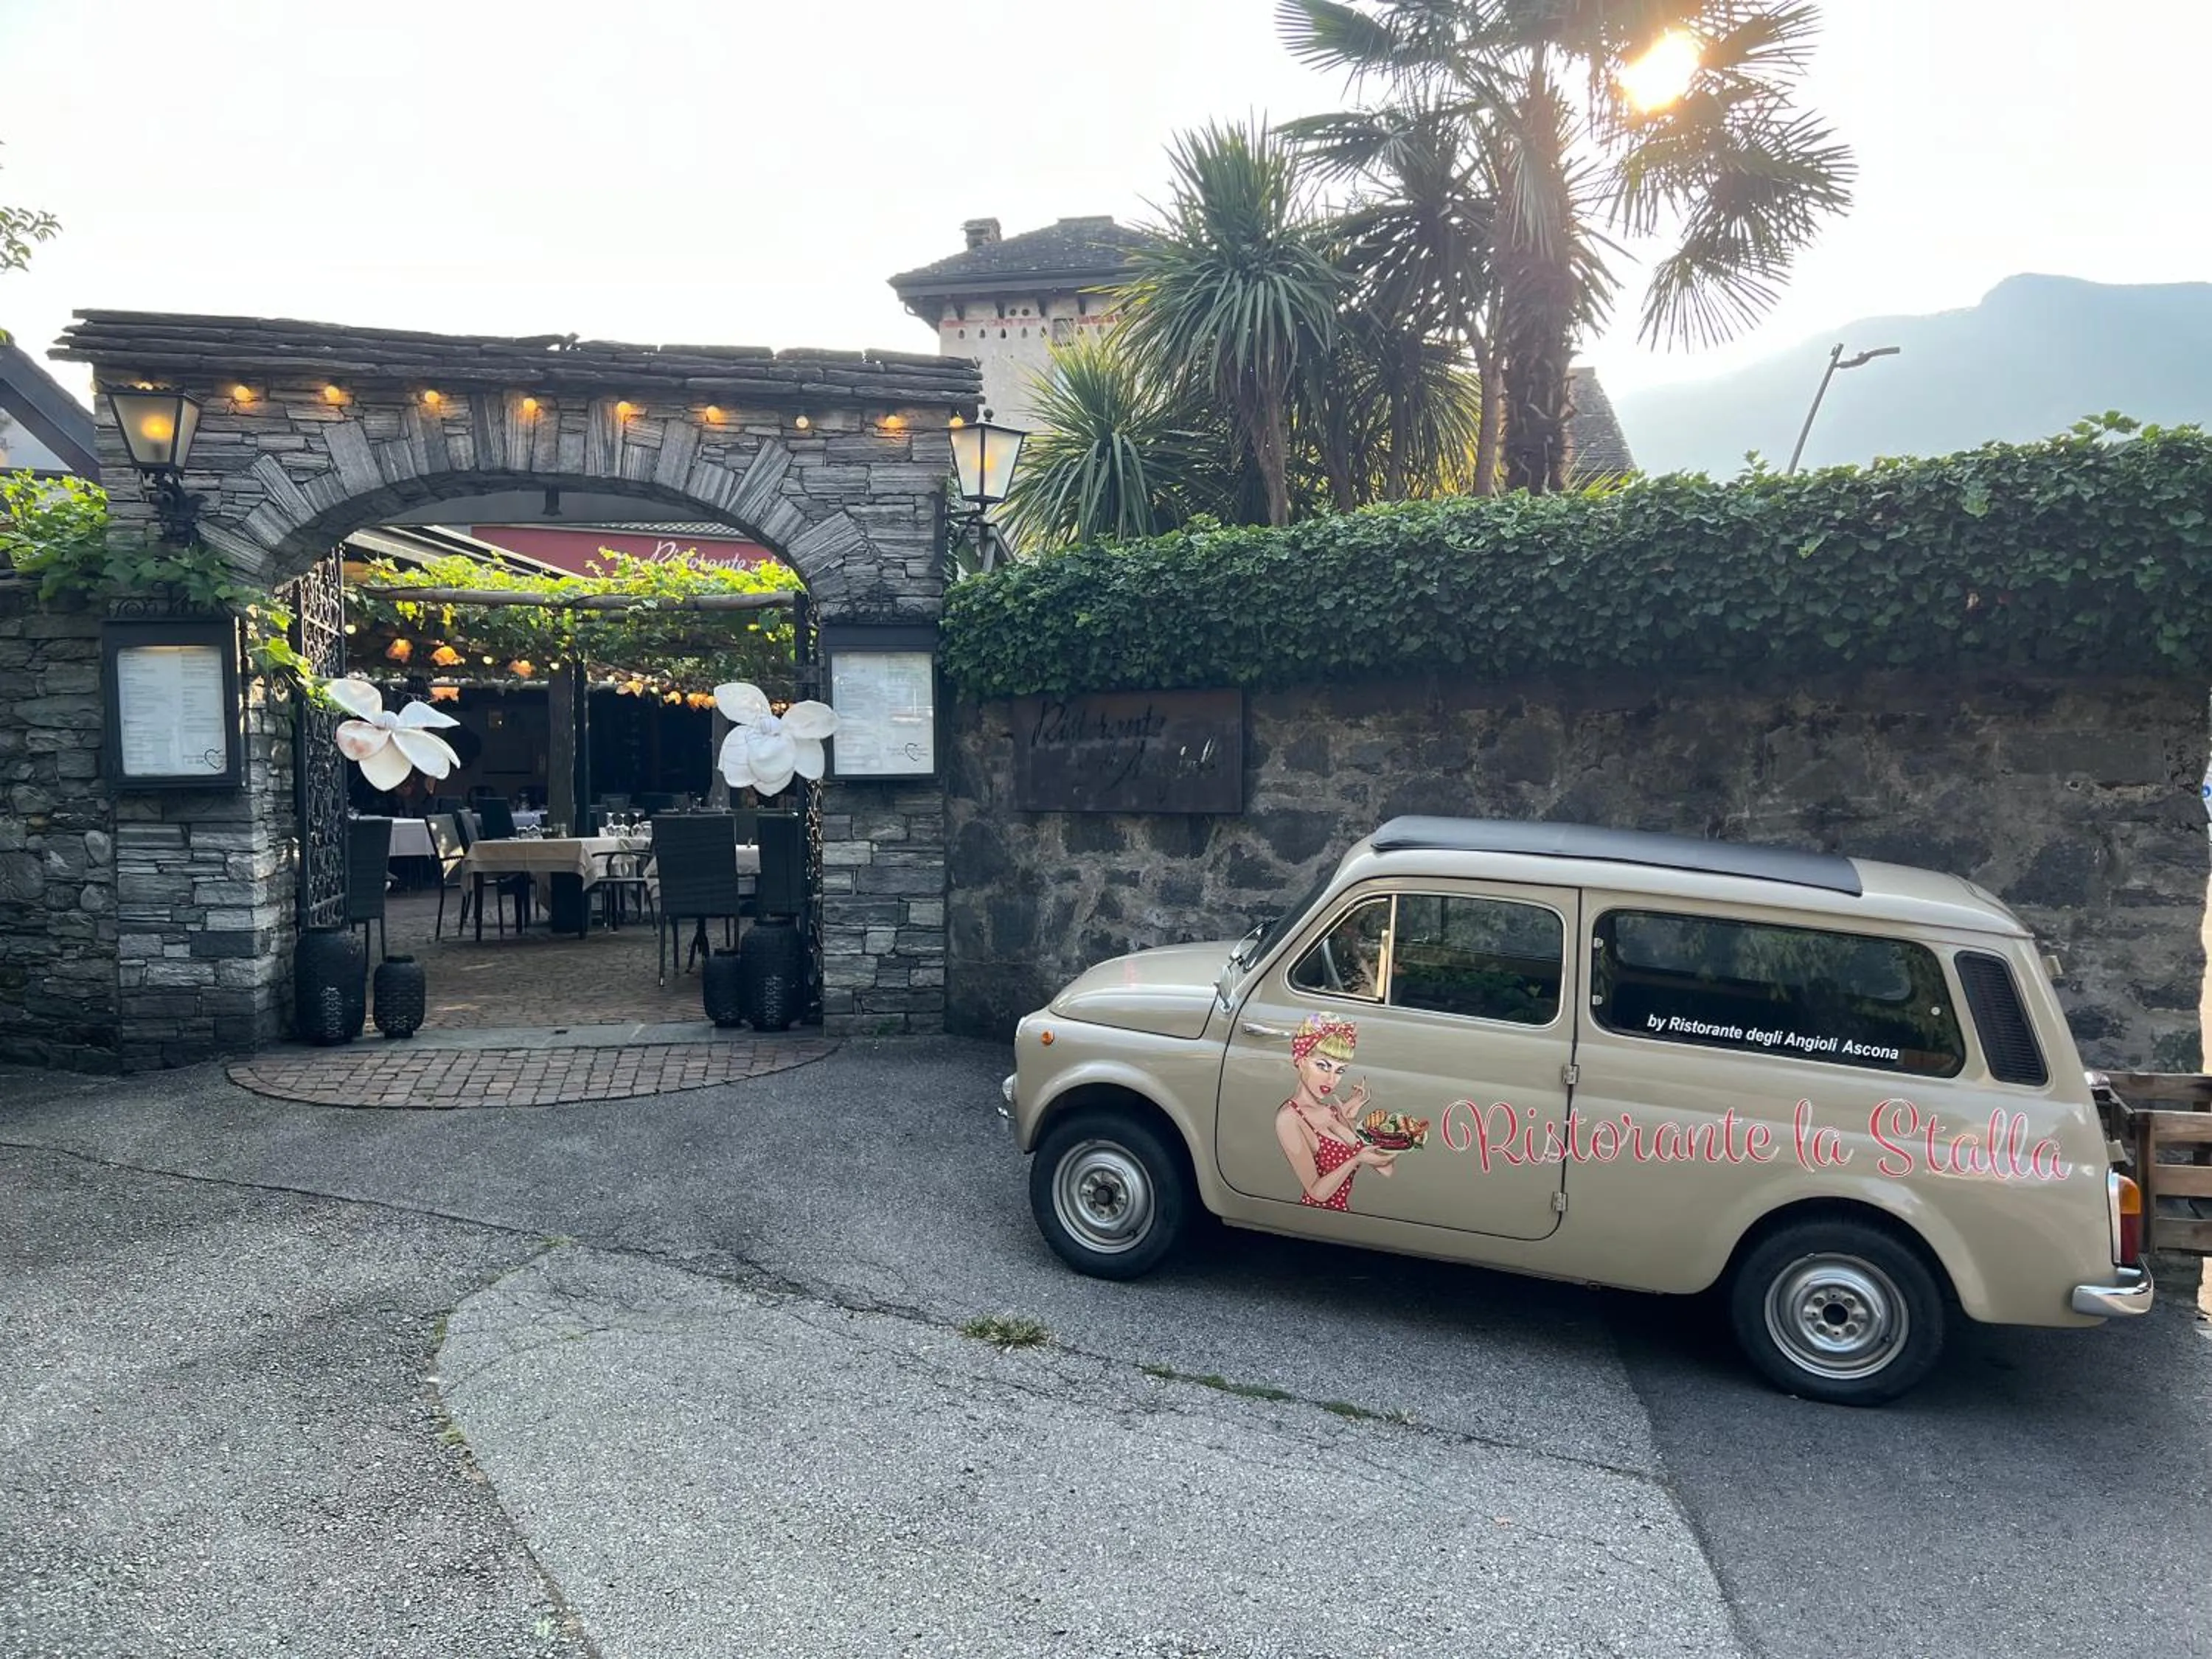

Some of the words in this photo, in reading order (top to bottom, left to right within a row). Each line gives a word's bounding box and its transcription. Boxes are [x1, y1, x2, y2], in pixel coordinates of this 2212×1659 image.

[1646, 1014, 1666, 1032] by
[1668, 1016, 1743, 1039] Ristorante
[1745, 1027, 1784, 1046] degli
[1784, 1032, 1838, 1052] Angioli
[1841, 1039, 1899, 1060] Ascona
[1440, 1098, 1780, 1174] Ristorante
[1792, 1097, 1854, 1174] la
[1868, 1097, 2073, 1180] Stalla
